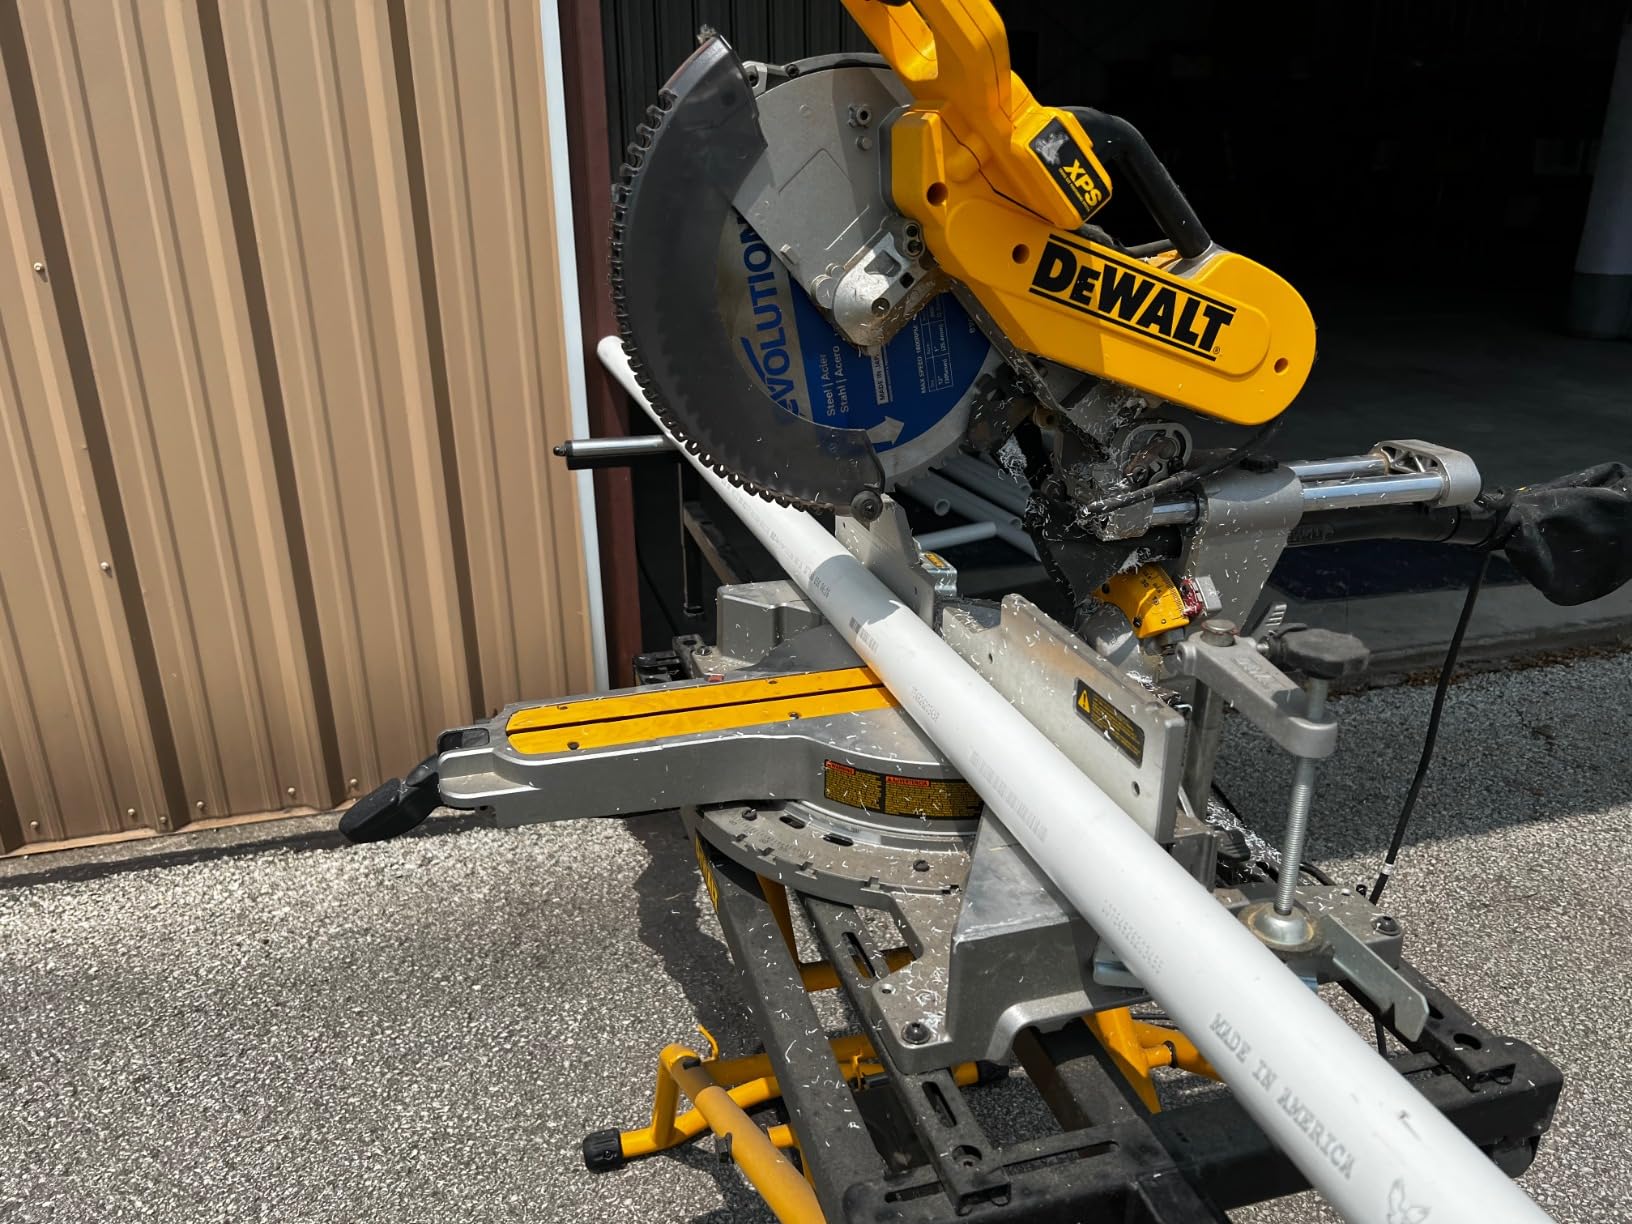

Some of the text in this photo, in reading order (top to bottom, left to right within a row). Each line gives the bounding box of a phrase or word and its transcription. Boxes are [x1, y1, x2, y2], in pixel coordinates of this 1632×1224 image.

[1062, 158, 1102, 206] XPS
[823, 388, 836, 417] Steel
[833, 346, 849, 413] Stahl Acero
[1209, 1013, 1355, 1180] MADE IN AMERICA
